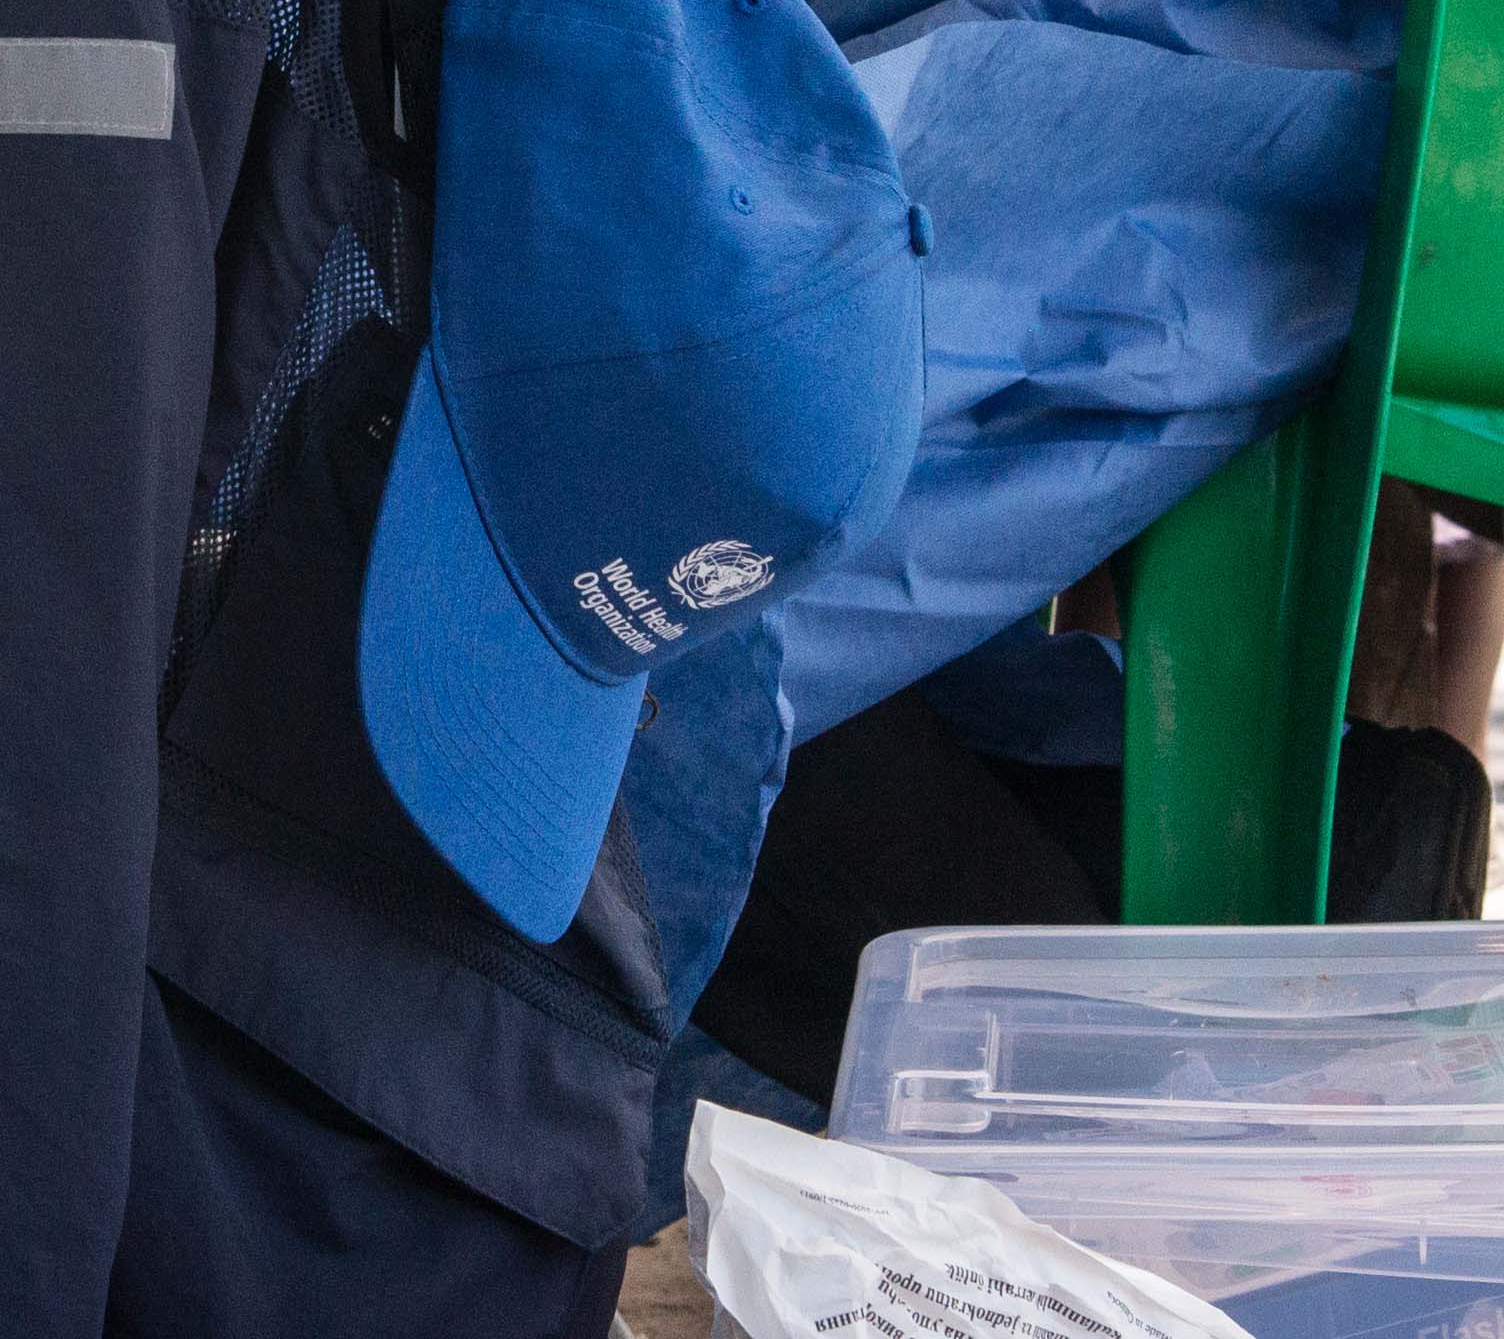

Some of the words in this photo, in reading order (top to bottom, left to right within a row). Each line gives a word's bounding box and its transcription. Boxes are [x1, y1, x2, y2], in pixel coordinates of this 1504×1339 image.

[573, 571, 657, 655] Organization
[600, 557, 656, 612] World
[638, 605, 689, 642] Health
[924, 1287, 1022, 1334] jednokratnu
